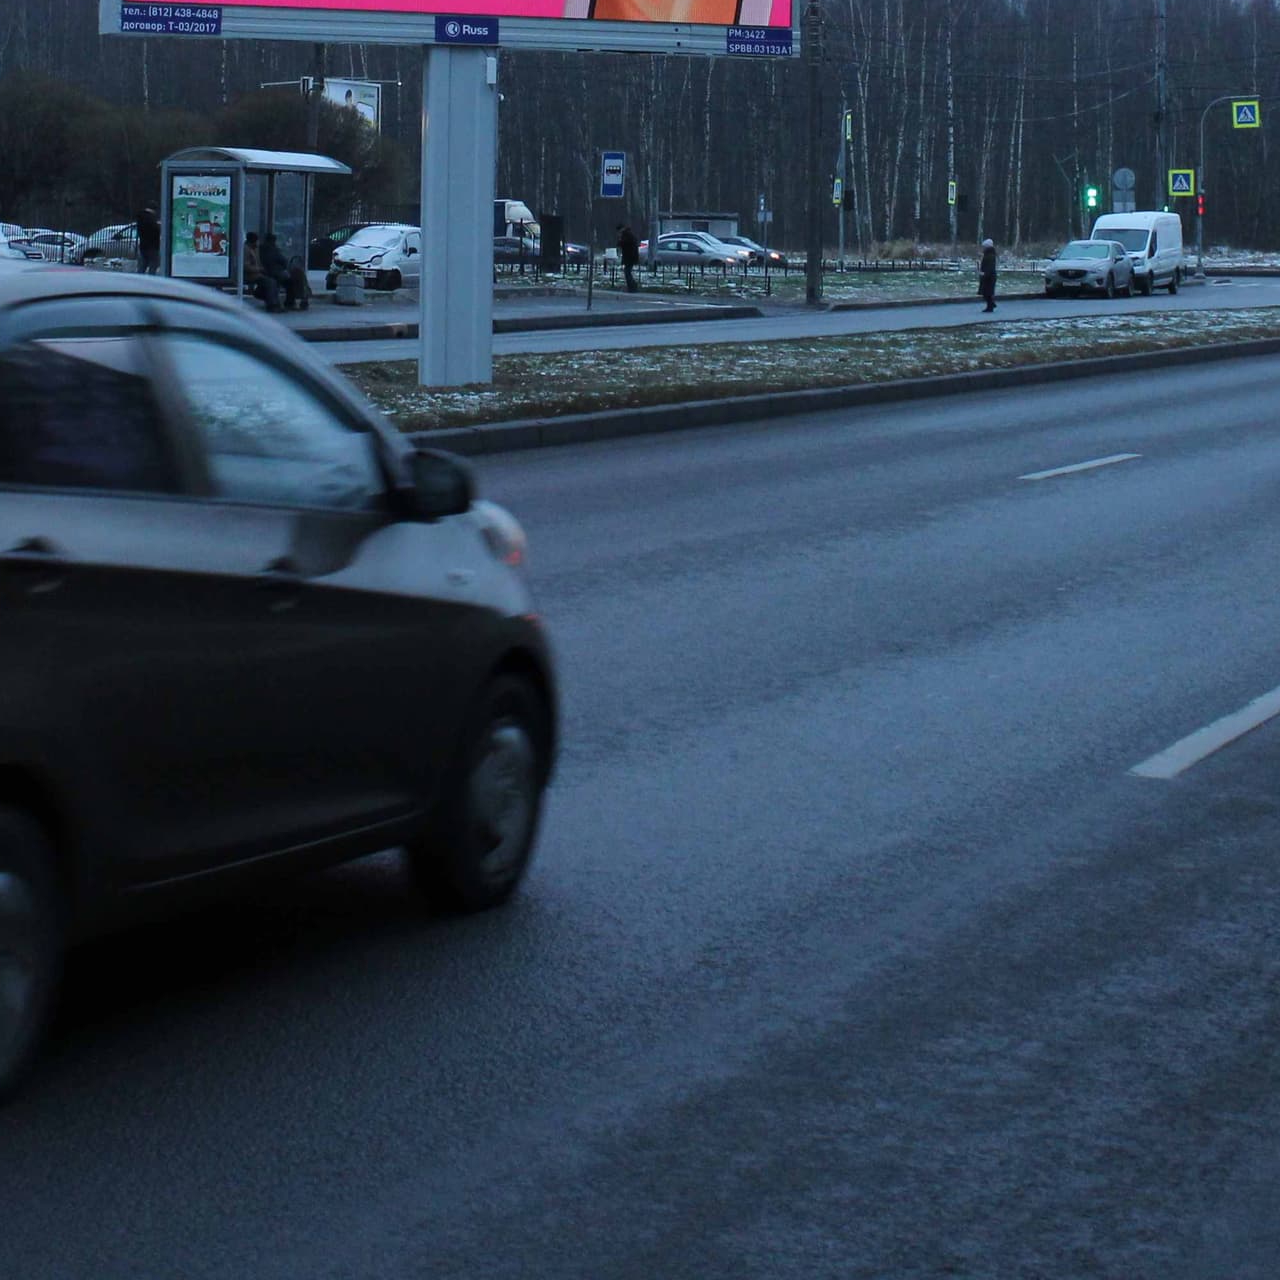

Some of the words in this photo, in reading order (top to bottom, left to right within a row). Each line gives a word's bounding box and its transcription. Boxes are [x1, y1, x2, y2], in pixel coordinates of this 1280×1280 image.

[123, 7, 147, 16] тел.:
[148, 5, 172, 17] (812)
[174, 7, 219, 19] 438-4848
[122, 21, 166, 32] договор:
[462, 24, 489, 36] Russ
